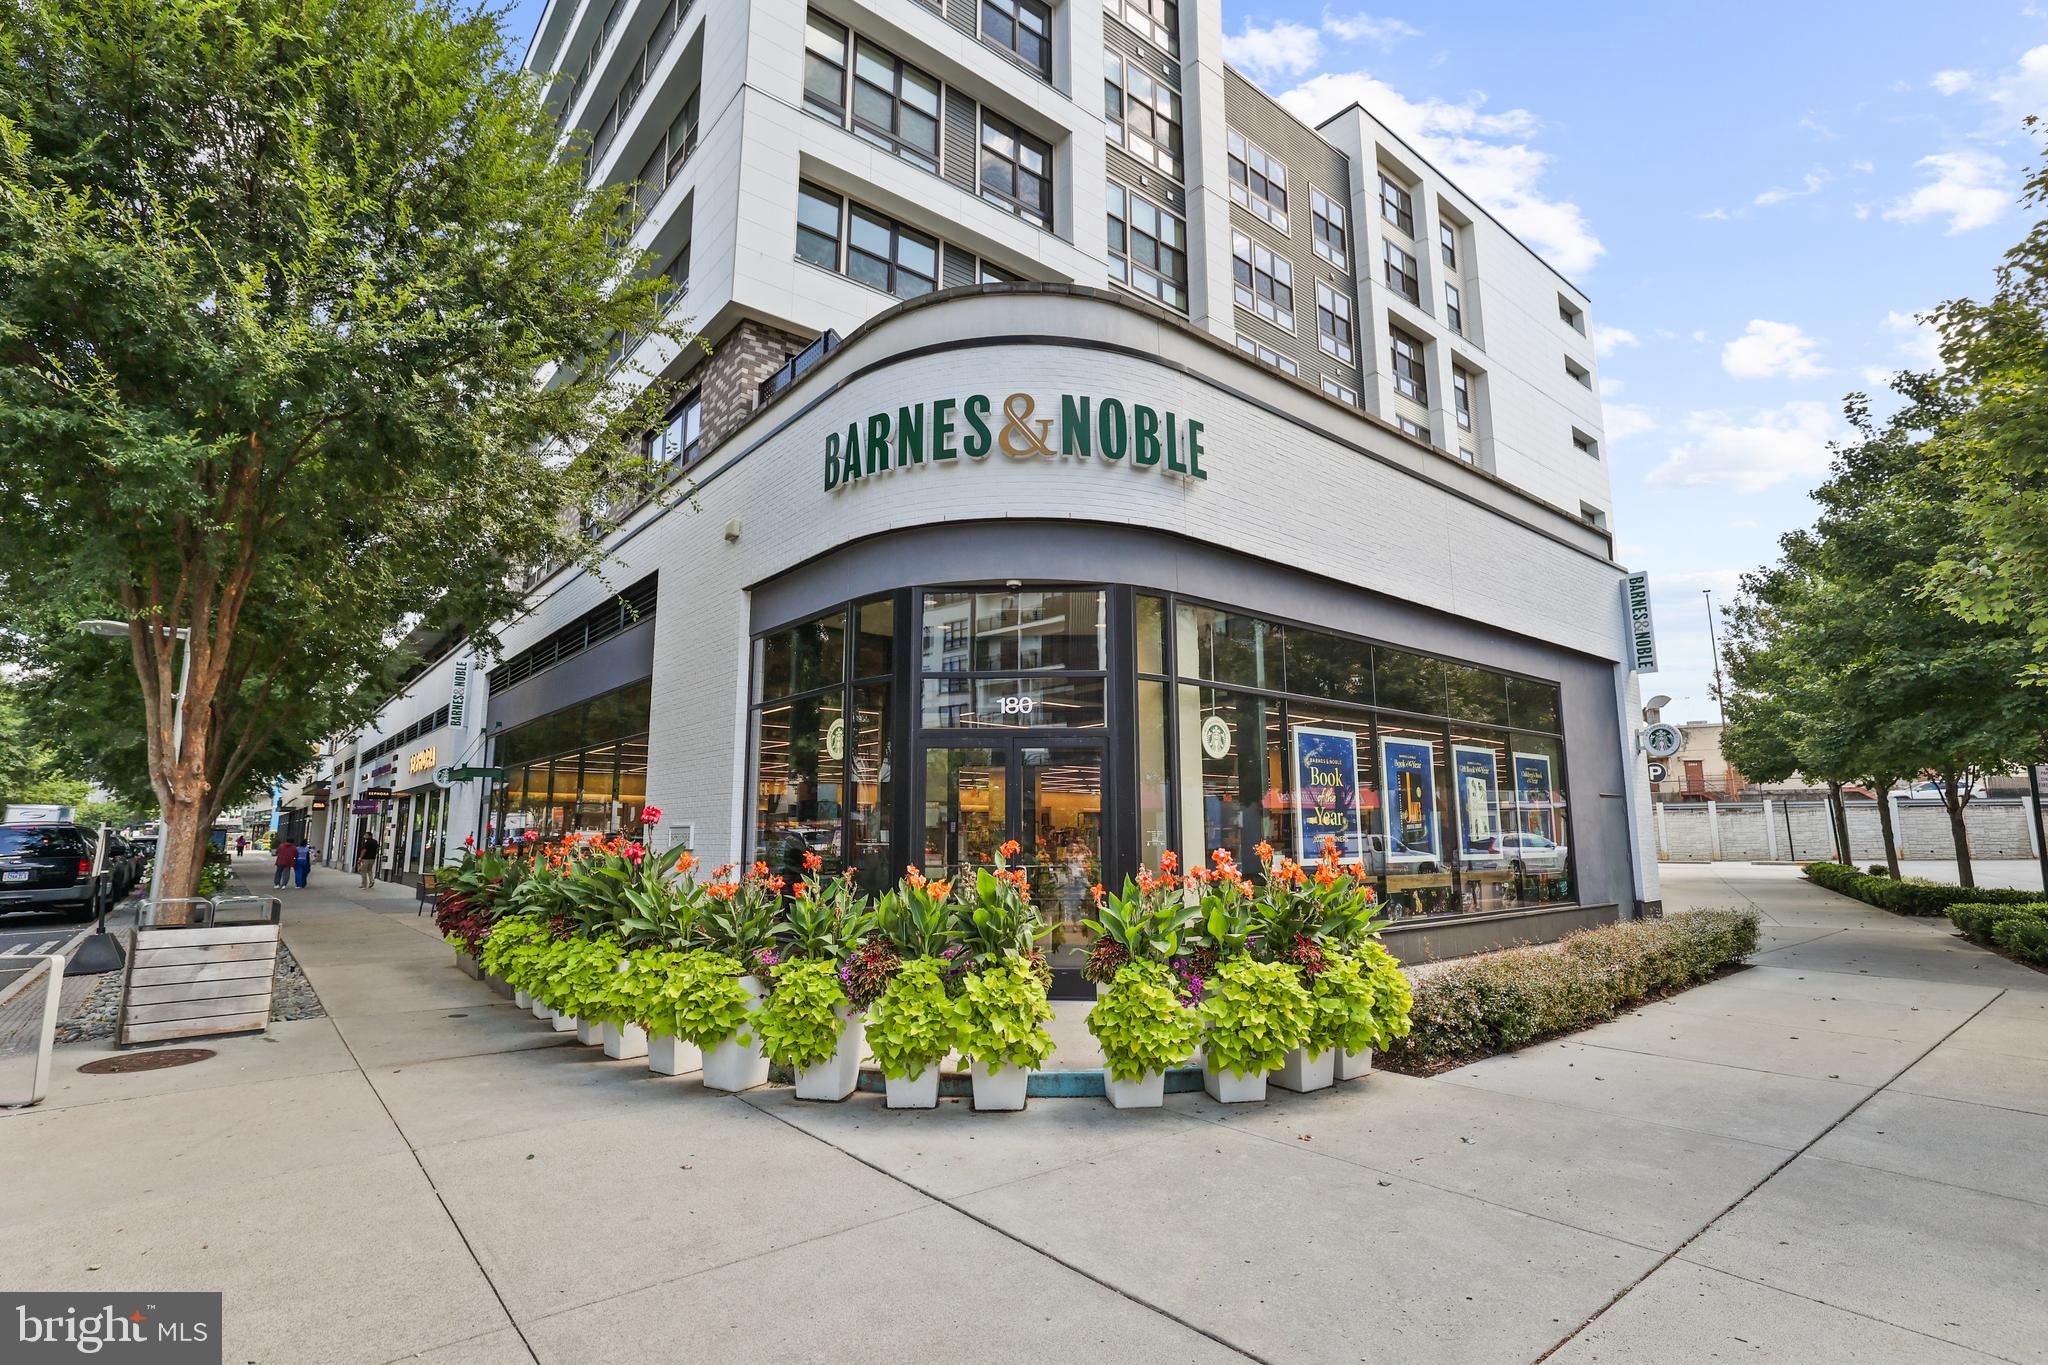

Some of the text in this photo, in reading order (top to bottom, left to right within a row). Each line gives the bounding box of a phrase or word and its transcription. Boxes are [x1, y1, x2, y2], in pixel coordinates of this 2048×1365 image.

[996, 696, 1033, 714] 180
[1310, 766, 1344, 787] Book
[1648, 765, 1662, 781] P
[1314, 806, 1344, 826] Year
